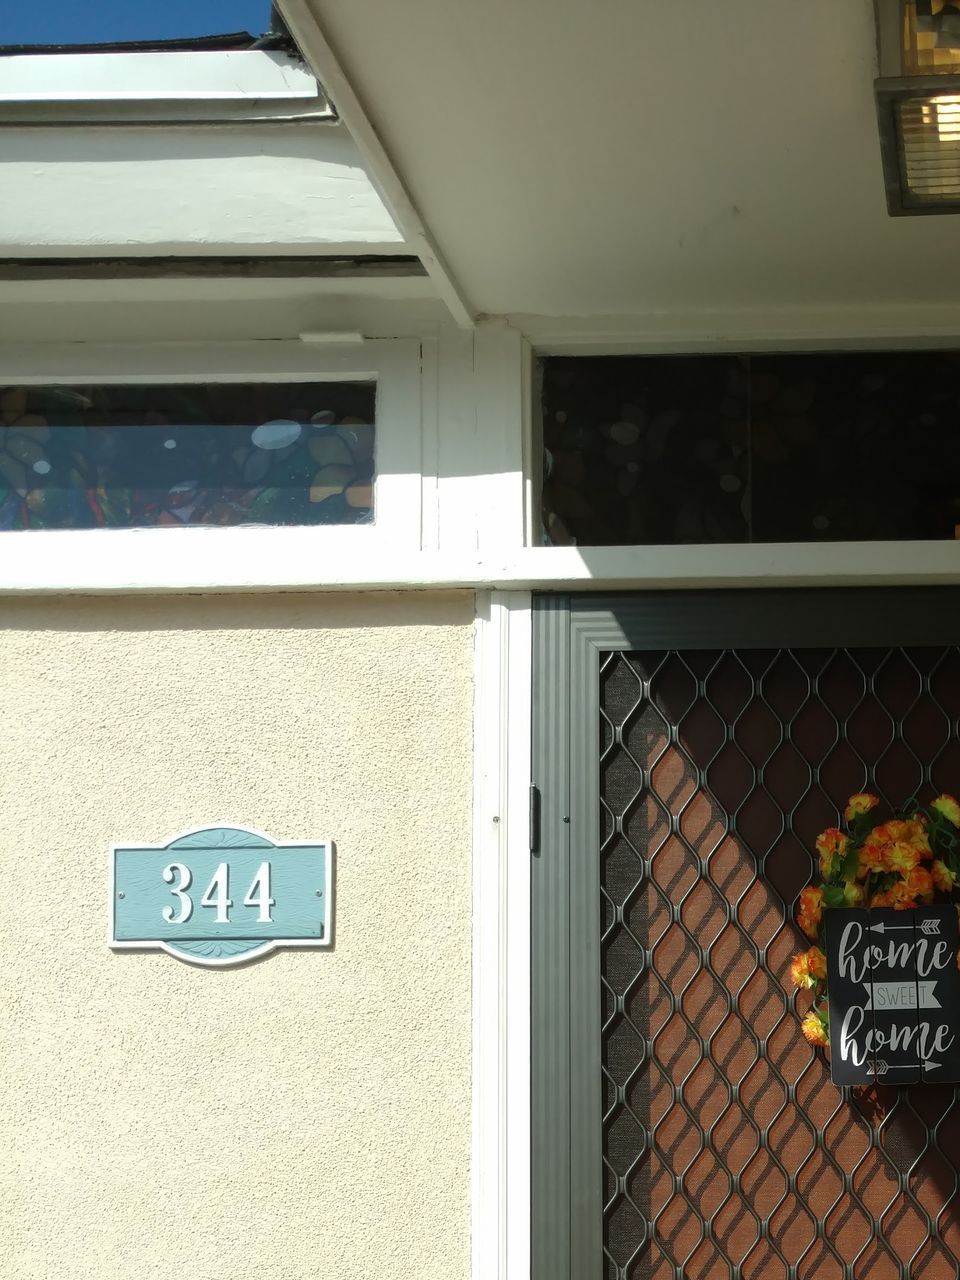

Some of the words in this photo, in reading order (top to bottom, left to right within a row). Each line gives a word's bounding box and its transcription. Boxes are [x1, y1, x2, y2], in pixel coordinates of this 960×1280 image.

[162, 862, 275, 924] 344
[839, 921, 954, 983] home
[876, 985, 928, 1006] SWEET
[840, 1005, 955, 1067] home
